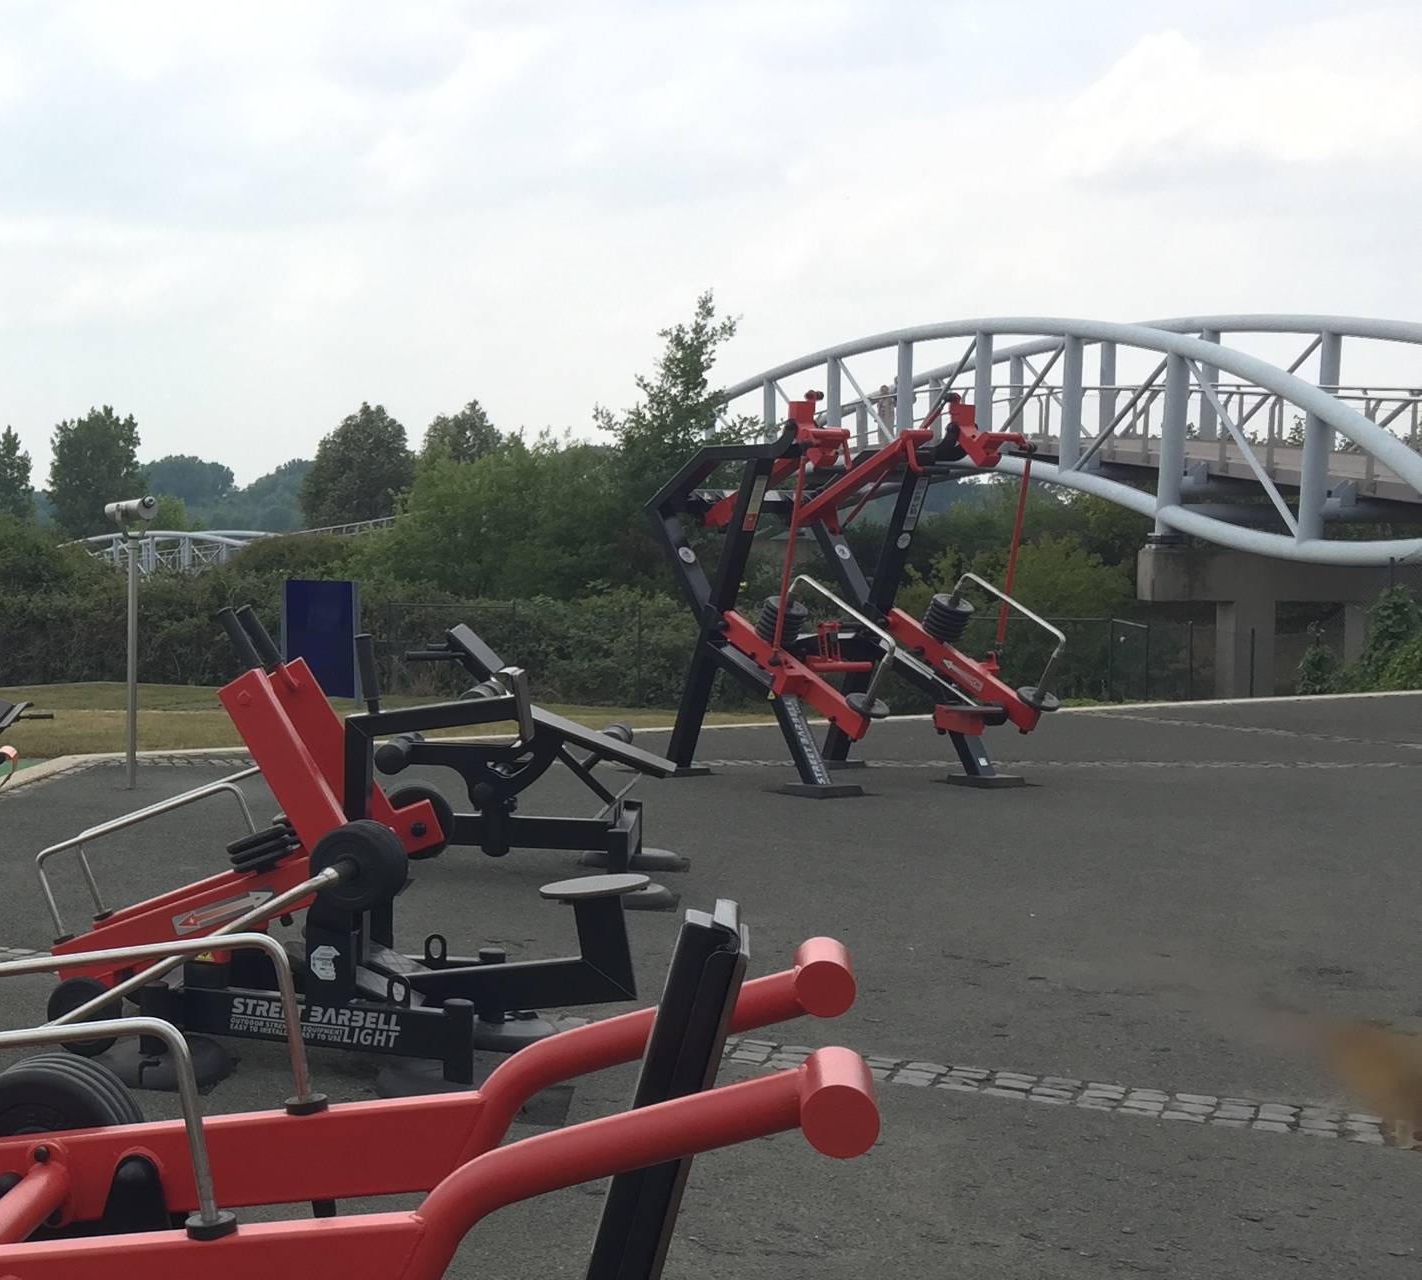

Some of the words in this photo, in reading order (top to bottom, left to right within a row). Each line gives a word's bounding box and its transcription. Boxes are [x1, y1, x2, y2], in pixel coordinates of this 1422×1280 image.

[230, 1017, 264, 1027] OUTDOOR
[231, 997, 306, 1021] STRET
[309, 1006, 401, 1031] BARBELL
[229, 1023, 247, 1032] EASY
[328, 1034, 341, 1042] USE
[342, 1027, 400, 1047] LIGHT
